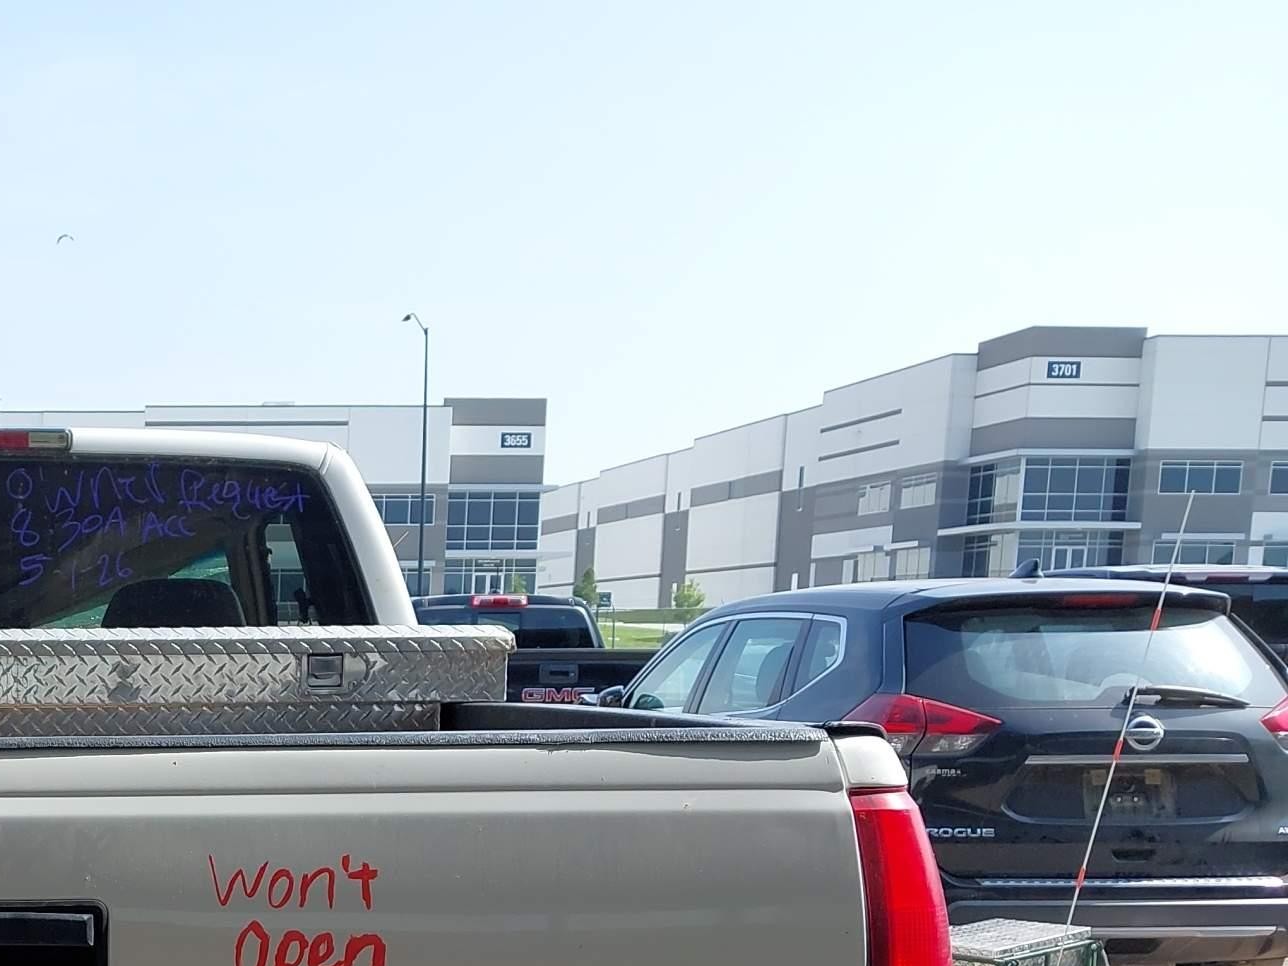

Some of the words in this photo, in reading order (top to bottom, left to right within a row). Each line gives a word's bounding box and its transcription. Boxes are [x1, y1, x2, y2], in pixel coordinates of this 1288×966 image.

[1051, 363, 1077, 377] 3701
[503, 434, 529, 446] 3655
[926, 827, 996, 838] ROGUE
[208, 853, 379, 911] Won't
